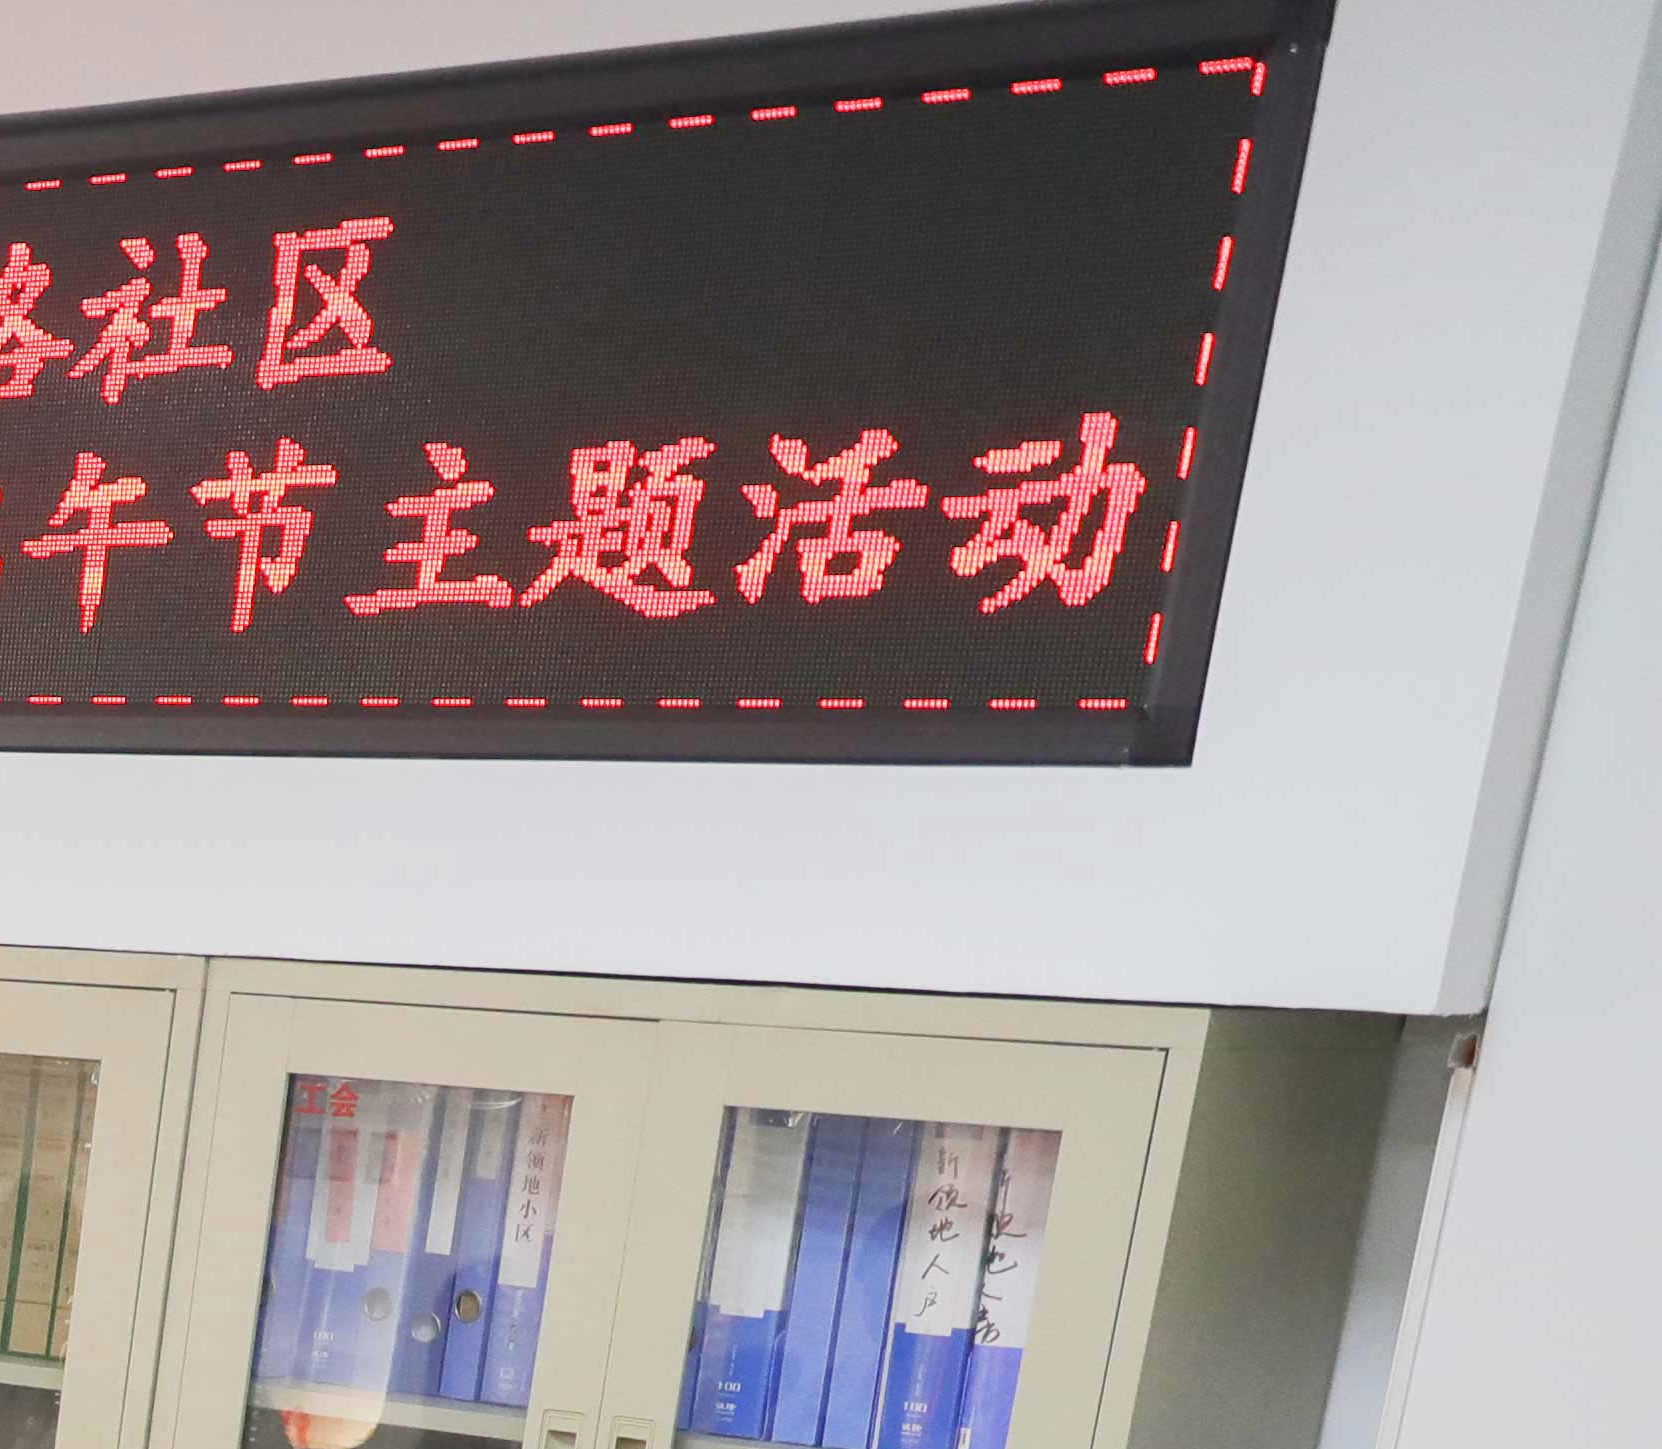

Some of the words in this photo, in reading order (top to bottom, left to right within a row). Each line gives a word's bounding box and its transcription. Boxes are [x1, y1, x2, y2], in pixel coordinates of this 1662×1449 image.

[294, 1082, 360, 1118] 工会
[514, 1128, 551, 1244] 新领地小区
